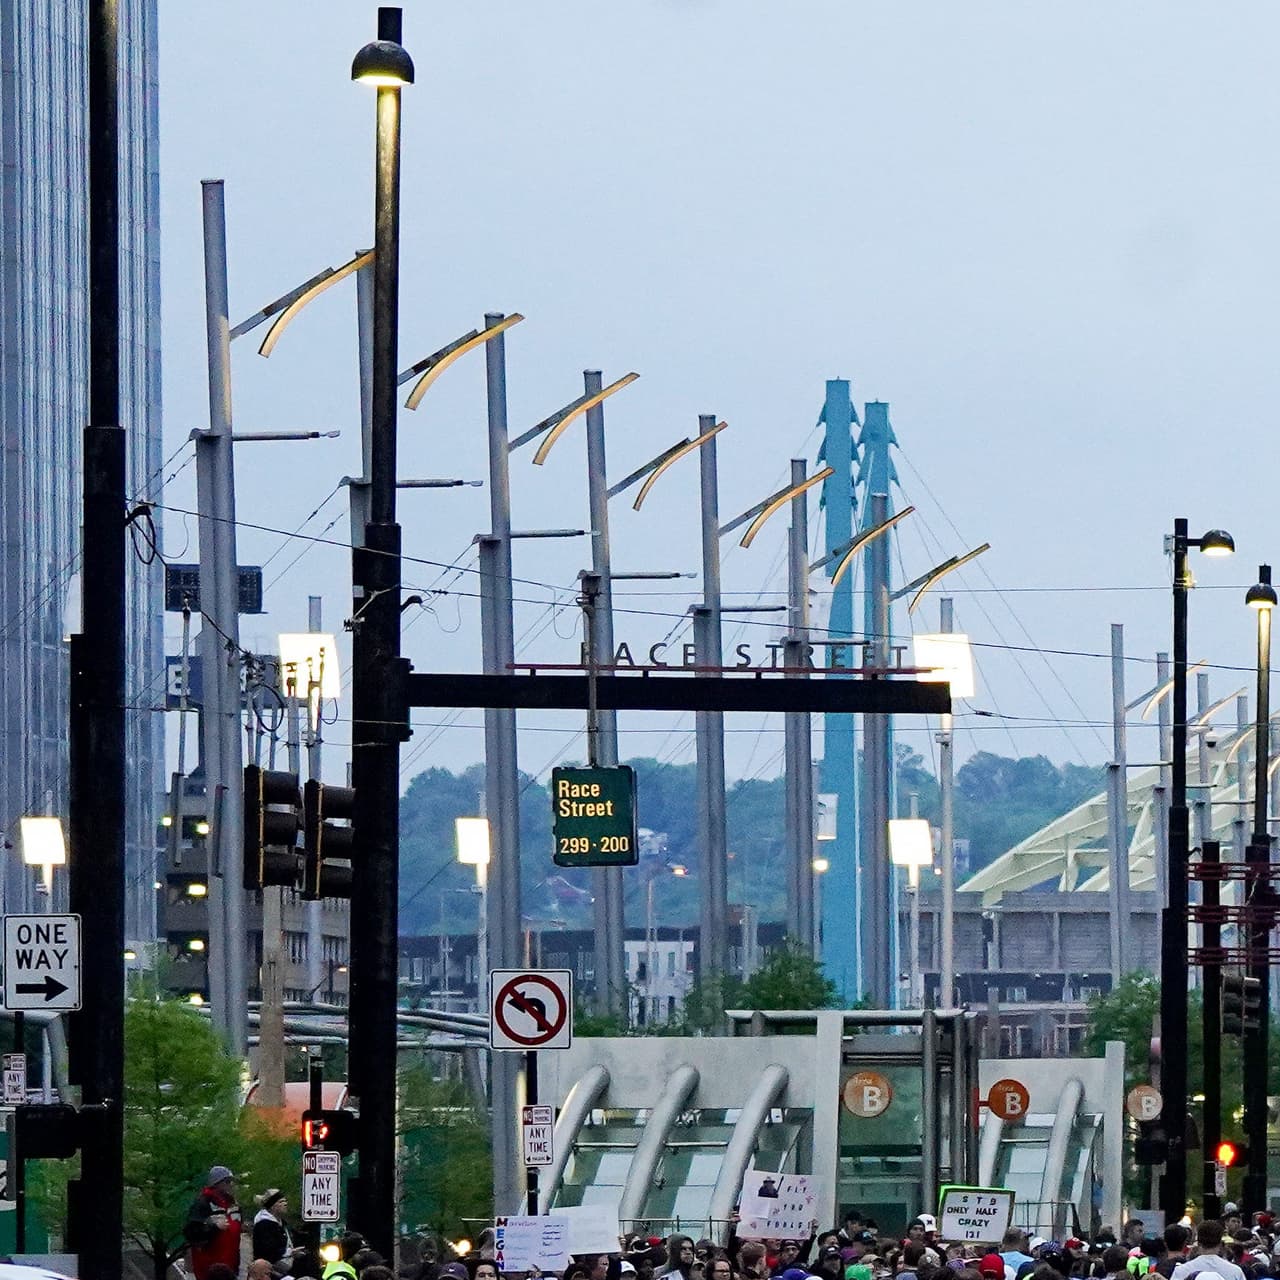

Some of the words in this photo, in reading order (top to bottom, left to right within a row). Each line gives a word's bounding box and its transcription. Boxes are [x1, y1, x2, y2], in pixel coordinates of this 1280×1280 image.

[736, 643, 908, 670] STREET
[558, 780, 601, 798] Race
[559, 799, 614, 817] Street
[17, 924, 68, 944] ONE
[15, 949, 69, 970] WAY
[863, 1086, 882, 1112] B
[1005, 1092, 1022, 1114] B
[1141, 1096, 1159, 1118] B
[529, 1127, 547, 1139] ANY
[529, 1141, 549, 1153] TIME
[305, 1157, 316, 1170] NO
[311, 1177, 331, 1190] ANY
[310, 1193, 332, 1206] TIME
[946, 1206, 970, 1214] ONLY
[975, 1207, 998, 1215] HALF
[958, 1218, 990, 1227] CRAZY
